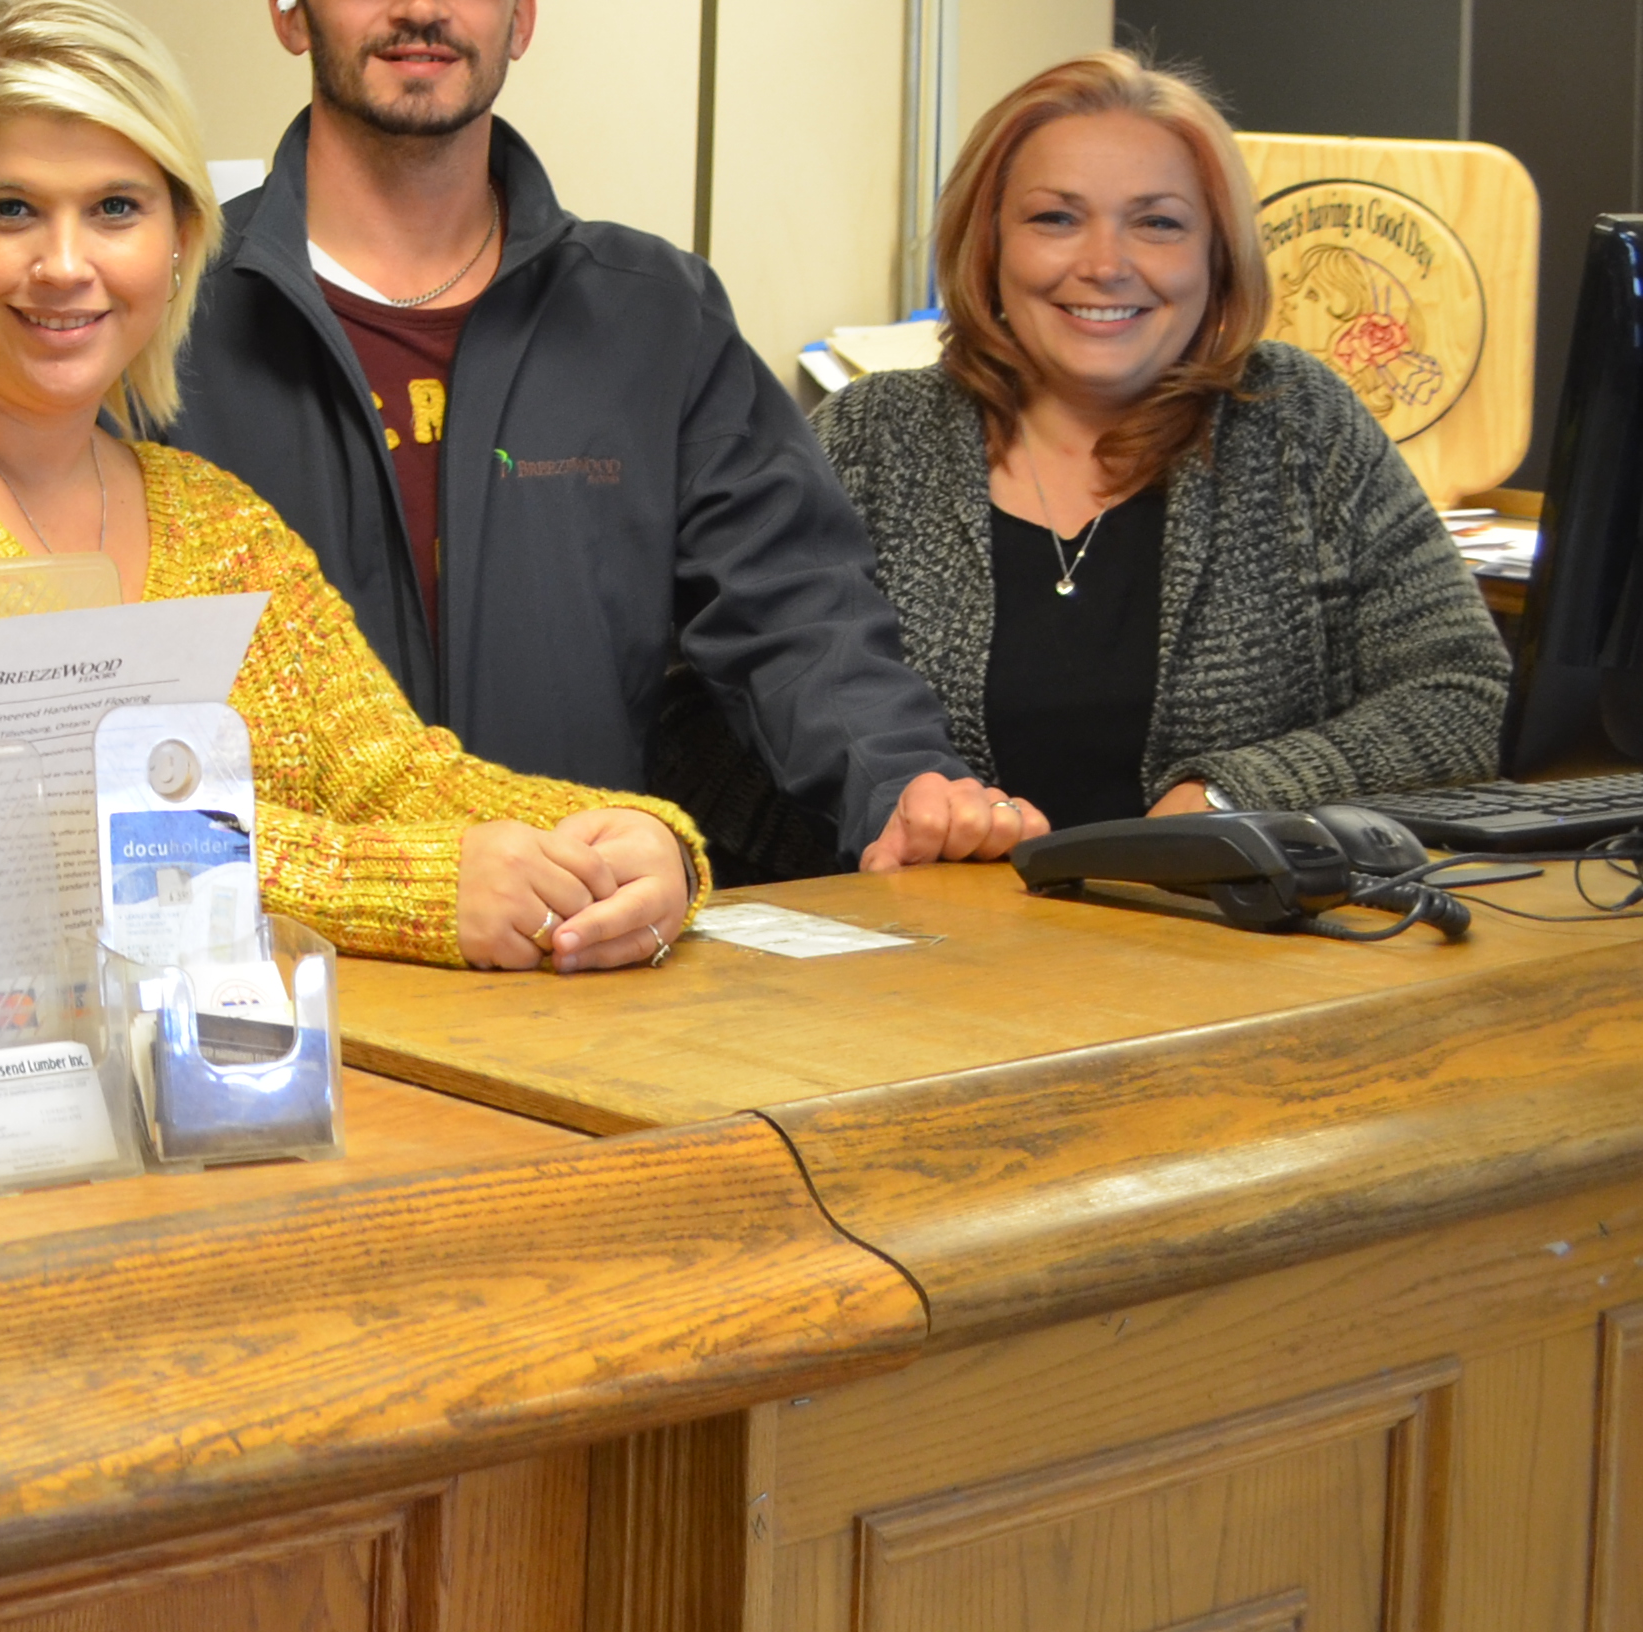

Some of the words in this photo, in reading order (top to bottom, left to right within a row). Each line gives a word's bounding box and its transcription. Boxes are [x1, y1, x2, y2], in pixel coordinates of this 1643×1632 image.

[1307, 191, 1352, 238] having
[1368, 198, 1407, 247] Good
[1406, 220, 1434, 279] Day
[78, 672, 117, 683] FLOORS
[42, 700, 102, 718] Hardwood
[104, 693, 151, 710] Flooring
[28, 1055, 66, 1073] Lumber
